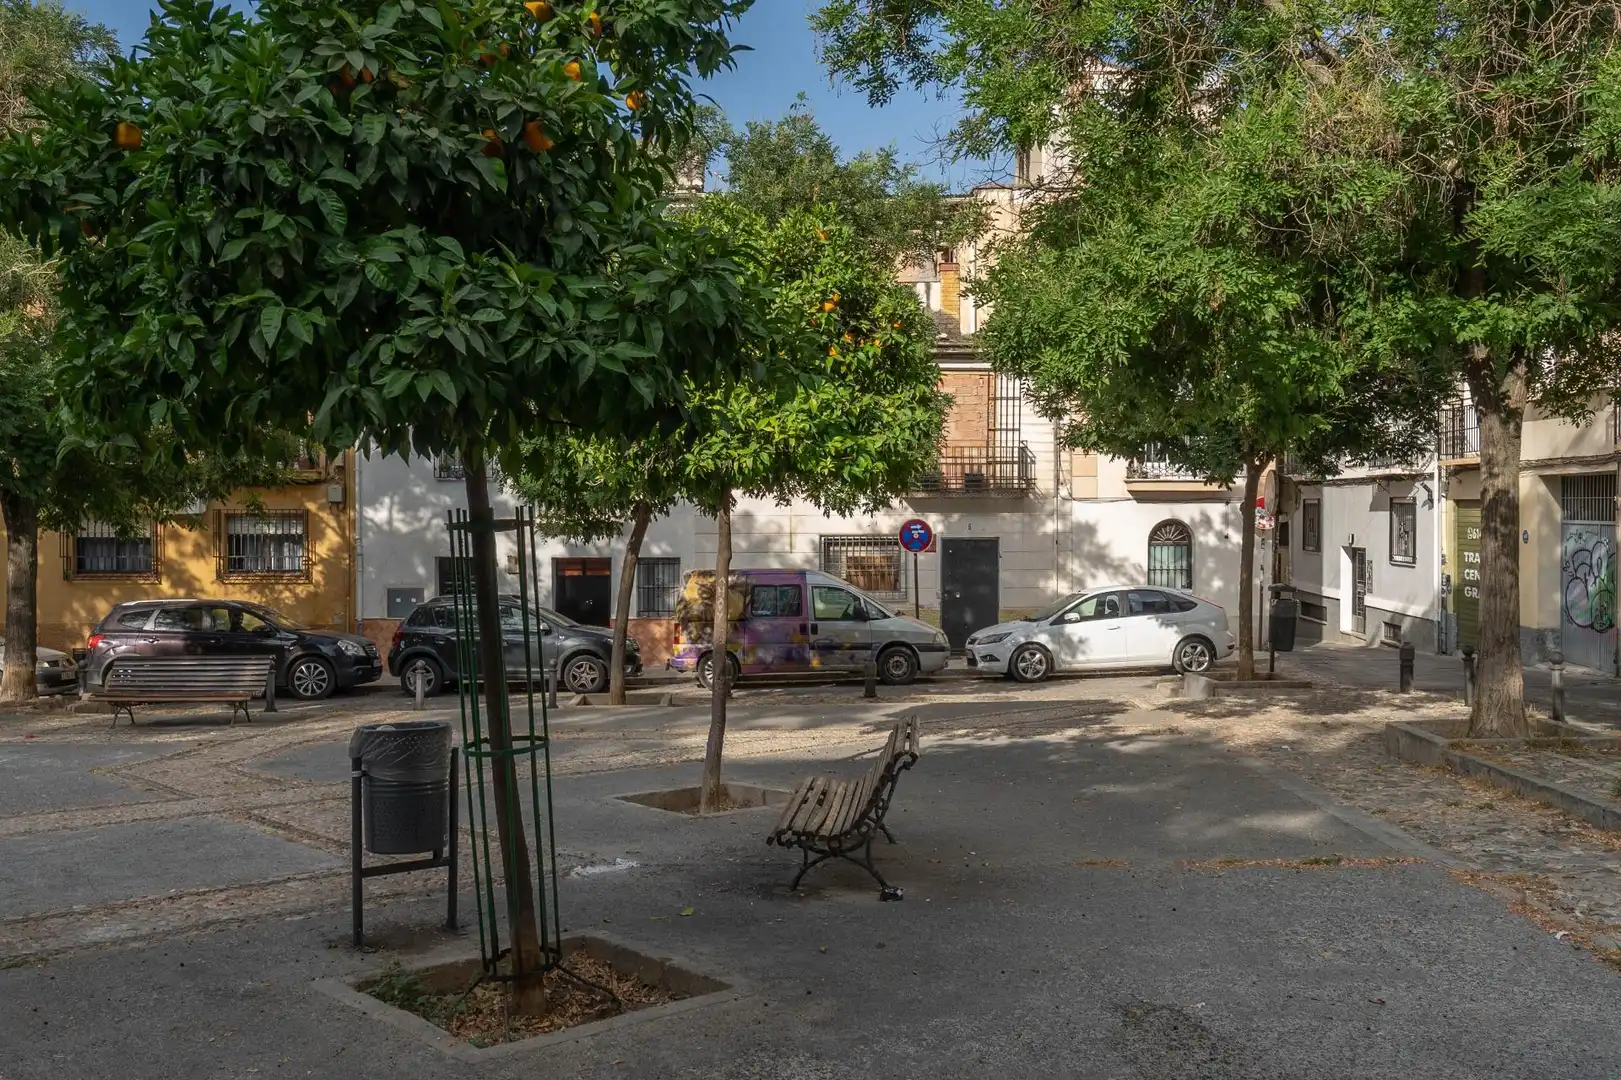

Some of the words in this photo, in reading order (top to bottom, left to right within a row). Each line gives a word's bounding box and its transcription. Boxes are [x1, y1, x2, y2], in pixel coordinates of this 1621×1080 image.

[1463, 551, 1480, 563] TRA
[1464, 568, 1480, 580] CEN
[1464, 586, 1480, 598] GR
